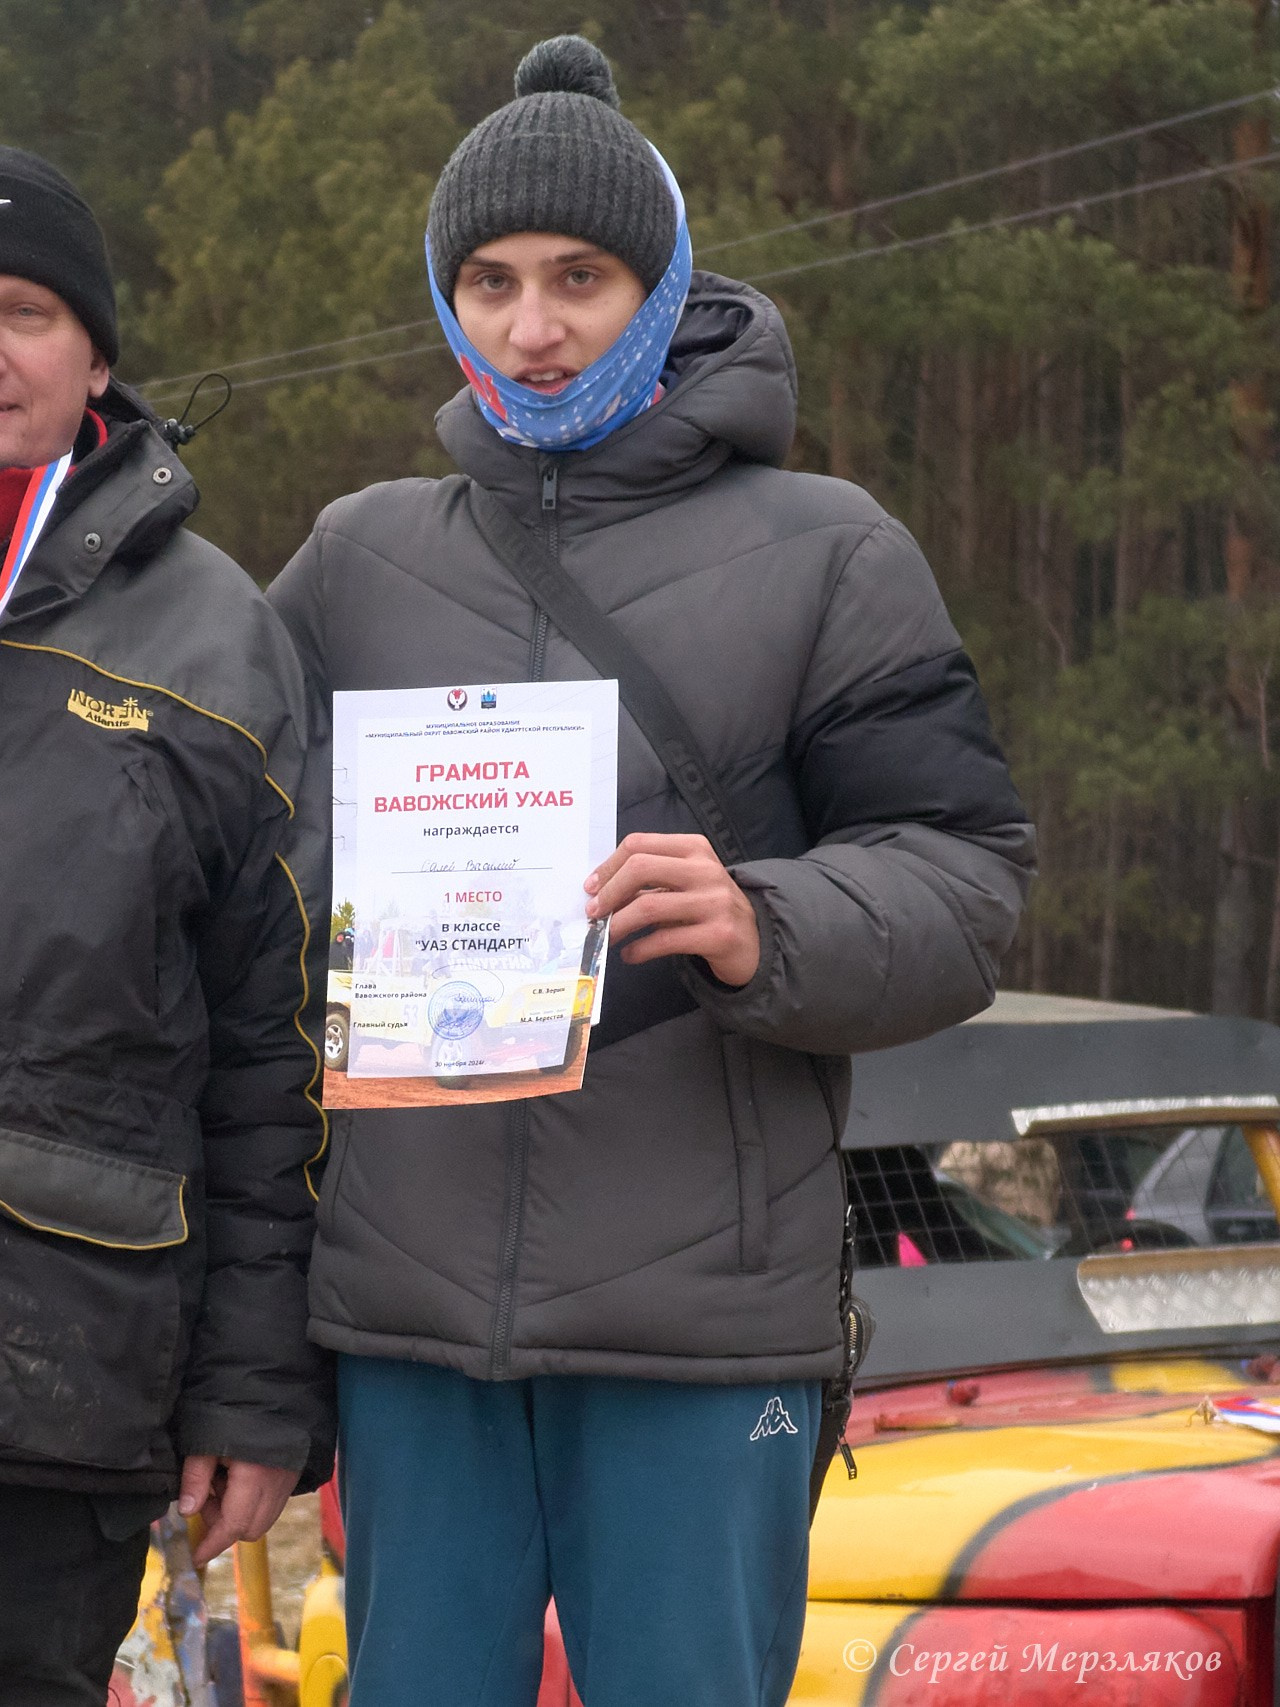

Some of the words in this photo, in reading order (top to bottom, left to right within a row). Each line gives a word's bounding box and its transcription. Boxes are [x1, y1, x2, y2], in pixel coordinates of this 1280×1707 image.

[86, 711, 131, 727] Atlantis
[416, 761, 530, 782] ГРАМОТА
[374, 788, 508, 813] ВАВОЖСКИЙ
[515, 790, 574, 808] УХАБ
[423, 824, 519, 838] награждается
[444, 892, 450, 903] 1
[455, 891, 503, 903] МЕСТО
[441, 923, 450, 933] в
[453, 922, 501, 932] классе
[415, 940, 448, 952] "УАЗ
[451, 938, 530, 952] СТАНДАРТ"
[400, 991, 427, 999] района
